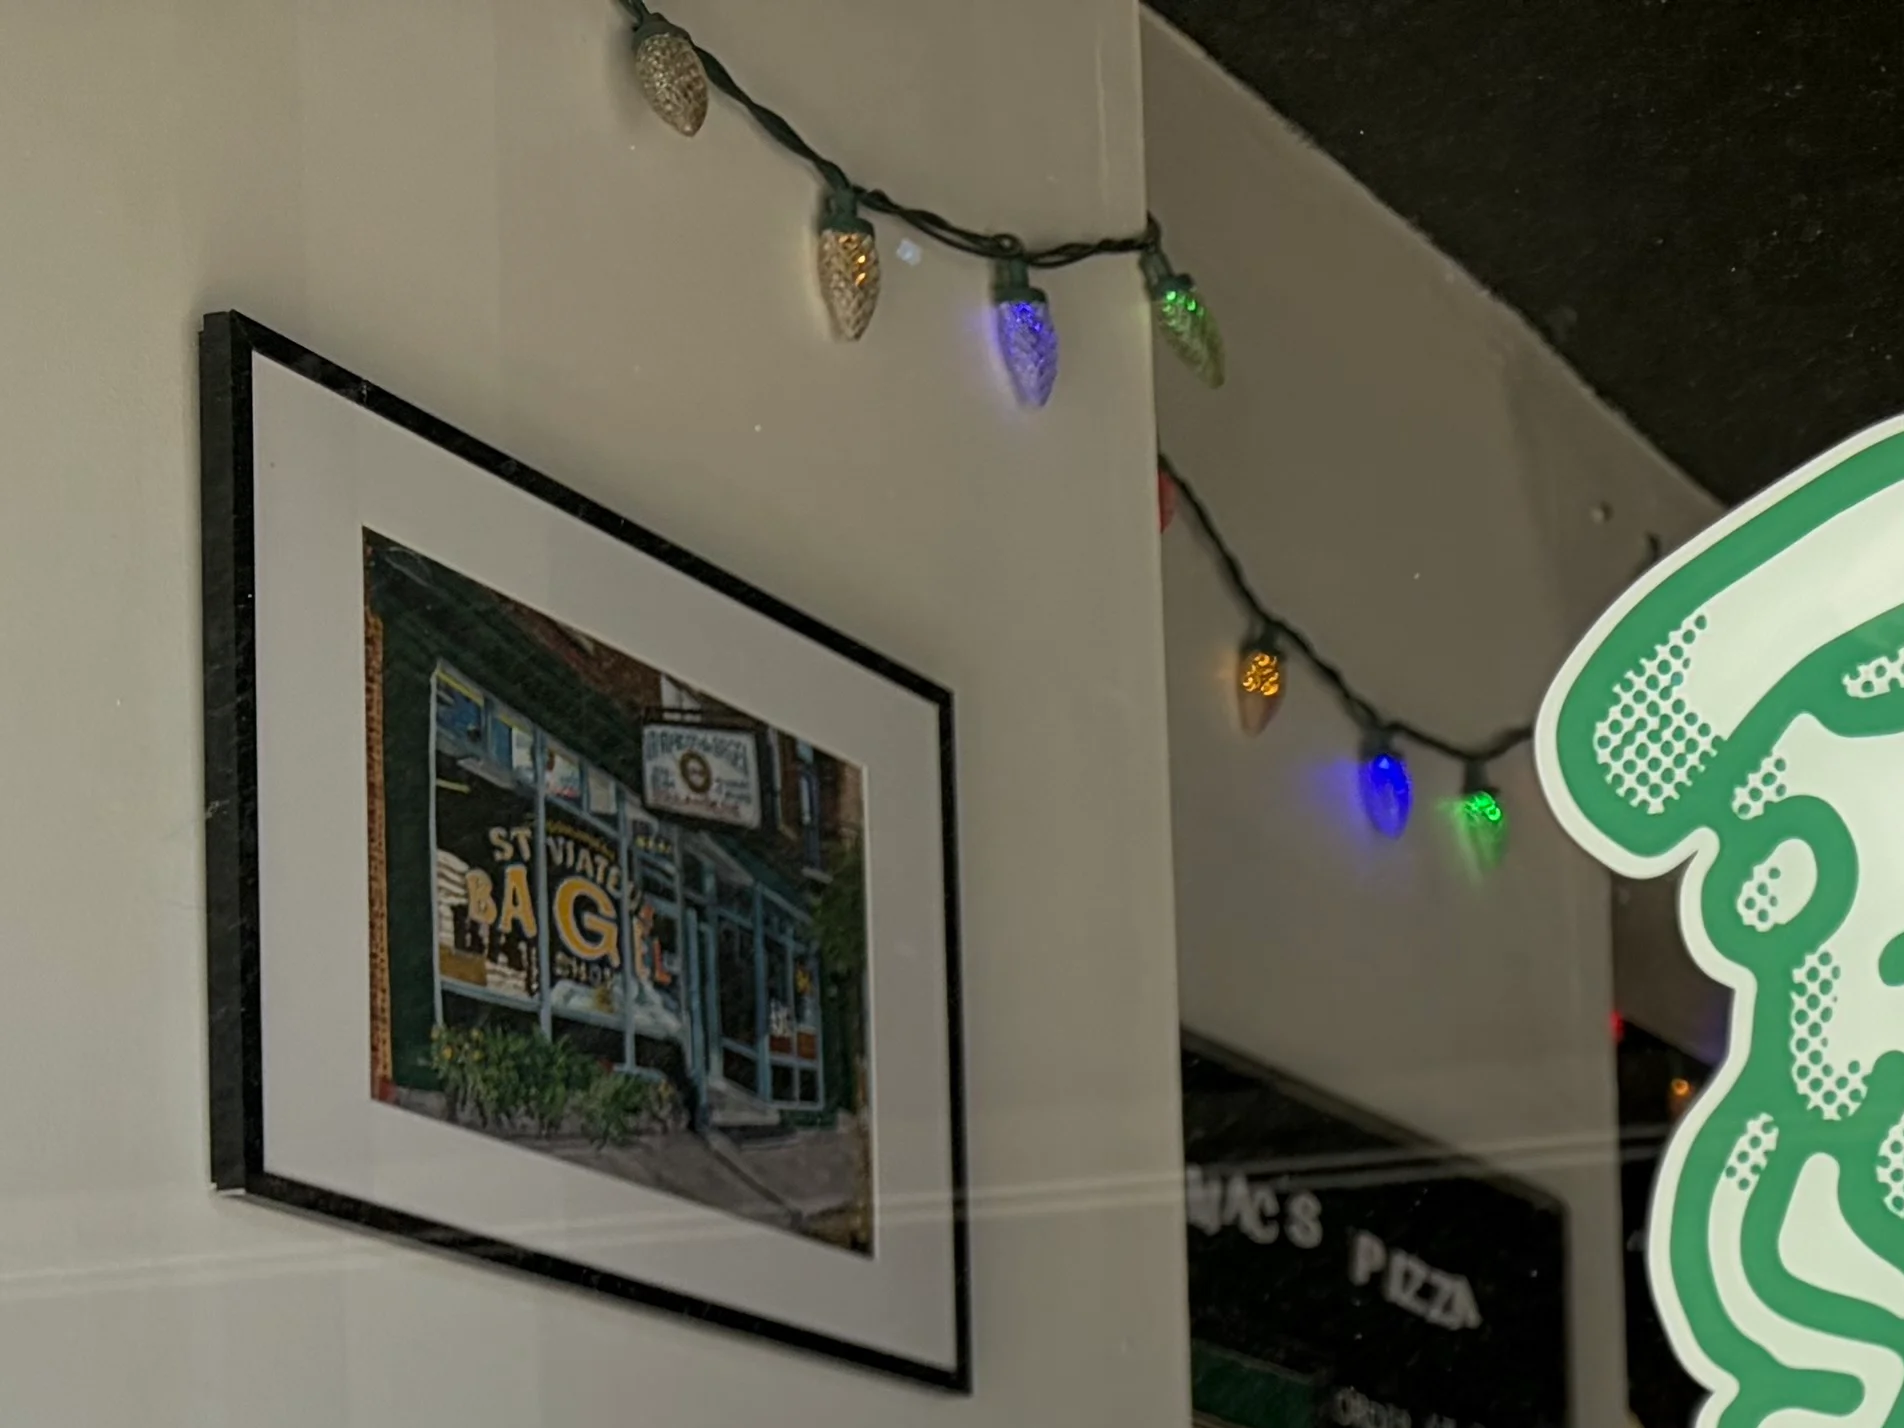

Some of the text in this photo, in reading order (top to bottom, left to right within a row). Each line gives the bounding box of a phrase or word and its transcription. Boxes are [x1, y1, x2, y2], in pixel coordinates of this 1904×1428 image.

[489, 826, 532, 862] ST
[465, 864, 673, 988] BAGEL
[1350, 1229, 1483, 1331] PIZZA
